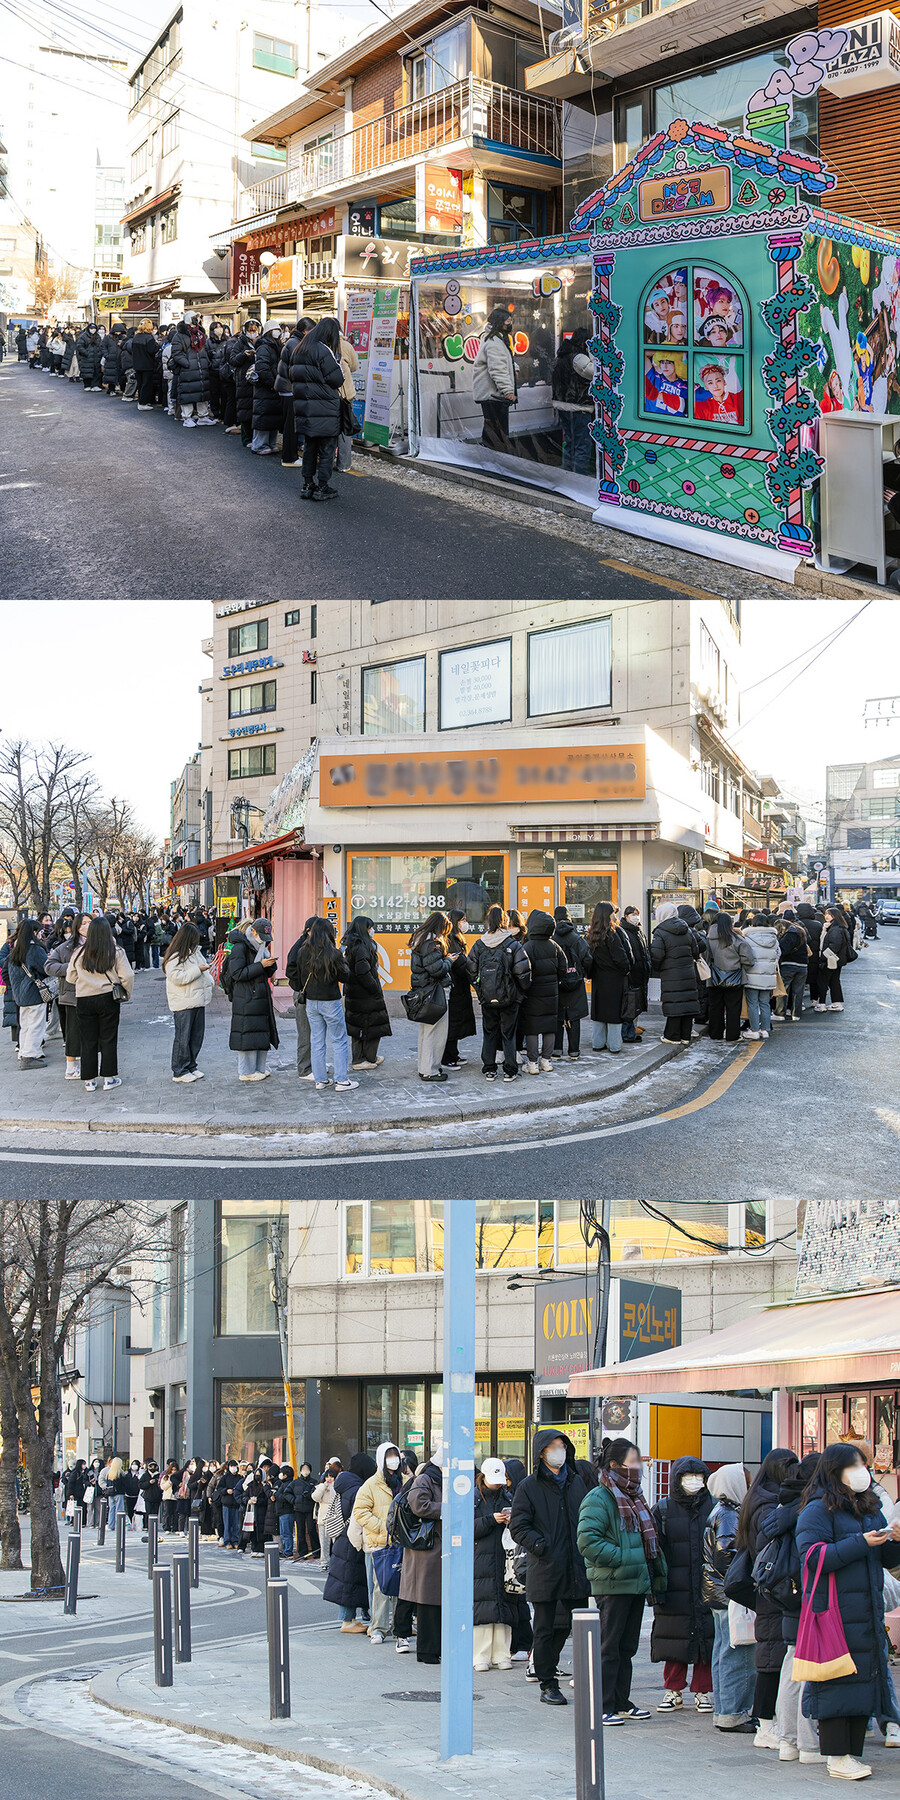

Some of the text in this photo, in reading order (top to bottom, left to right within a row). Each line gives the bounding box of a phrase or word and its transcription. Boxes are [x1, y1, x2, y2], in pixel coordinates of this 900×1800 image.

[846, 22, 878, 52] NI
[828, 47, 880, 72] PLAZA
[664, 178, 701, 198] NCT
[652, 190, 715, 215] DREAM
[359, 241, 400, 270] 우리
[450, 656, 502, 676] 네일꽃피다
[369, 895, 446, 908] 3142-4988
[543, 1297, 594, 1340] COIN
[622, 1302, 677, 1348] 코인노래
[543, 1364, 568, 1377] LUXURY
